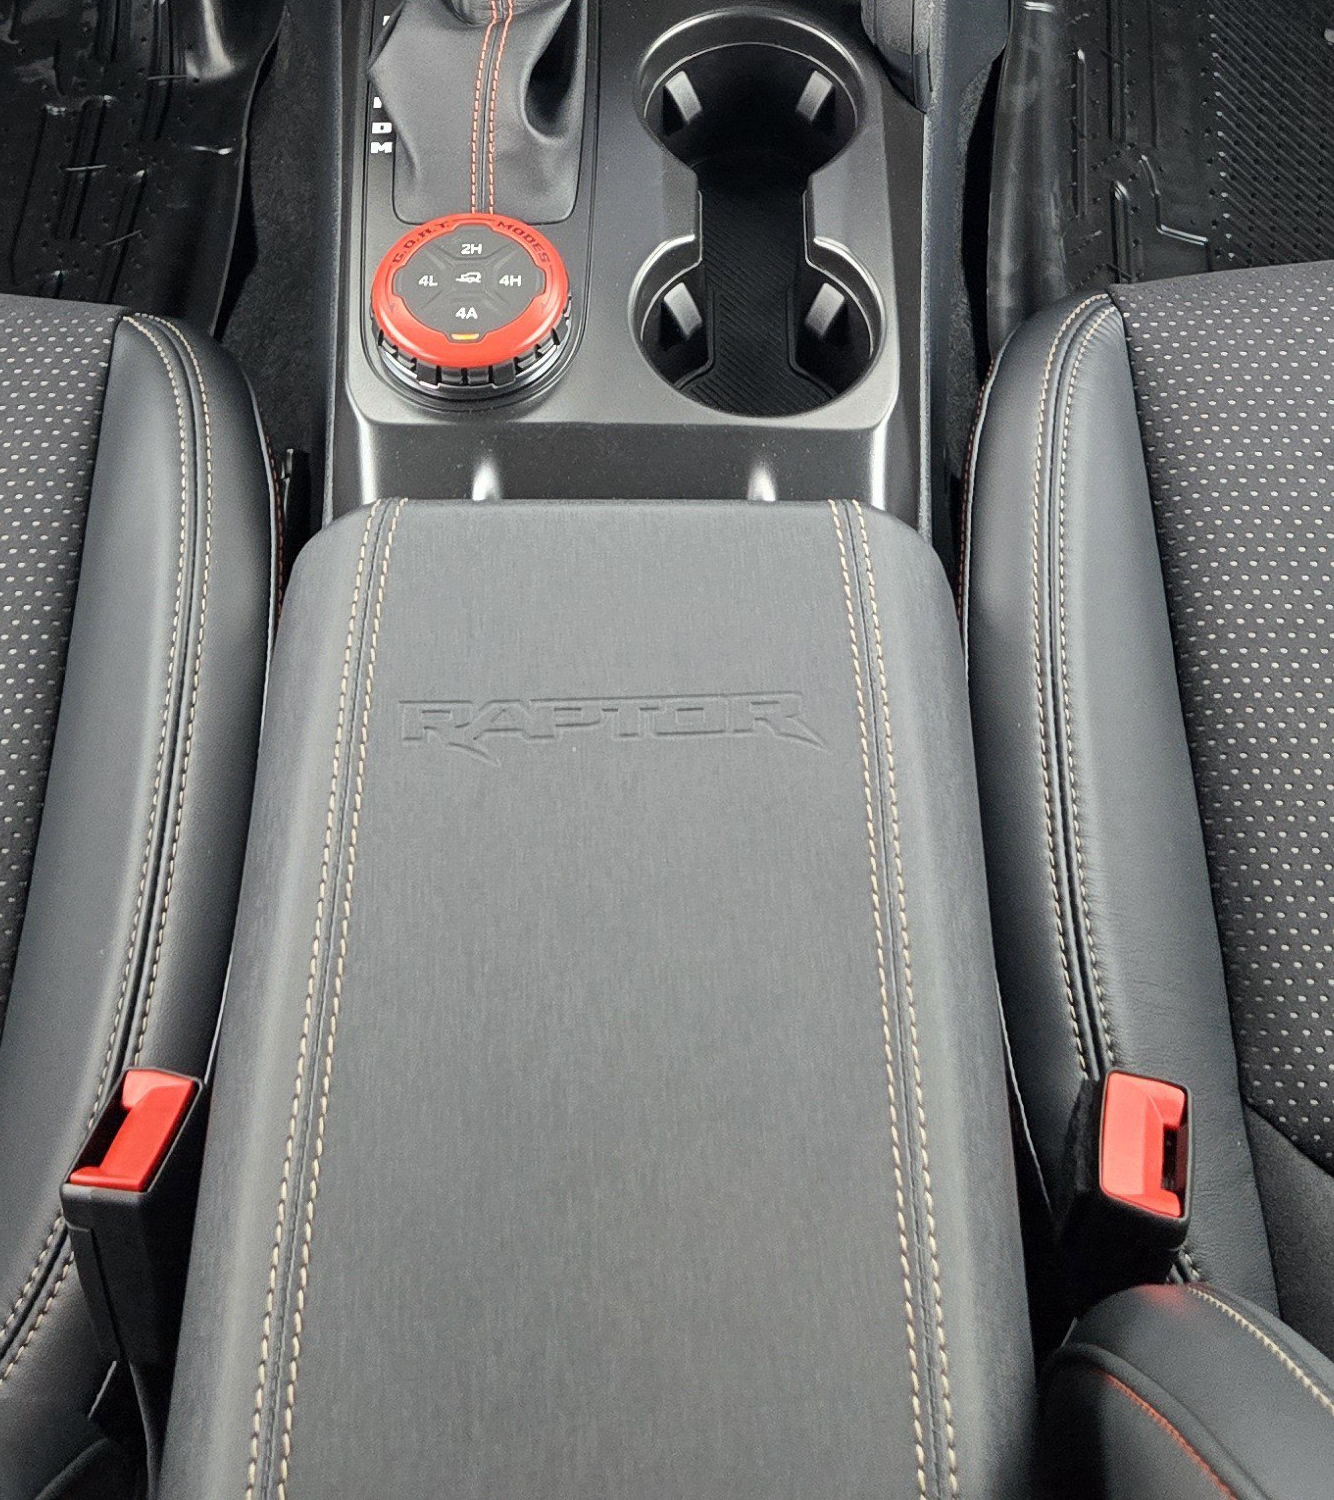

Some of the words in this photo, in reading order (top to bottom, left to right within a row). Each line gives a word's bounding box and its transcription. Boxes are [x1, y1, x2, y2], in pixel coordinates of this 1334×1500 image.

[371, 122, 393, 134] D
[370, 141, 393, 154] M
[497, 221, 550, 263] MODES
[460, 243, 483, 255] 2H
[418, 275, 438, 287] 4L
[499, 275, 522, 287] 4H
[455, 307, 478, 320] 4A
[398, 691, 829, 767] RAPTOR
